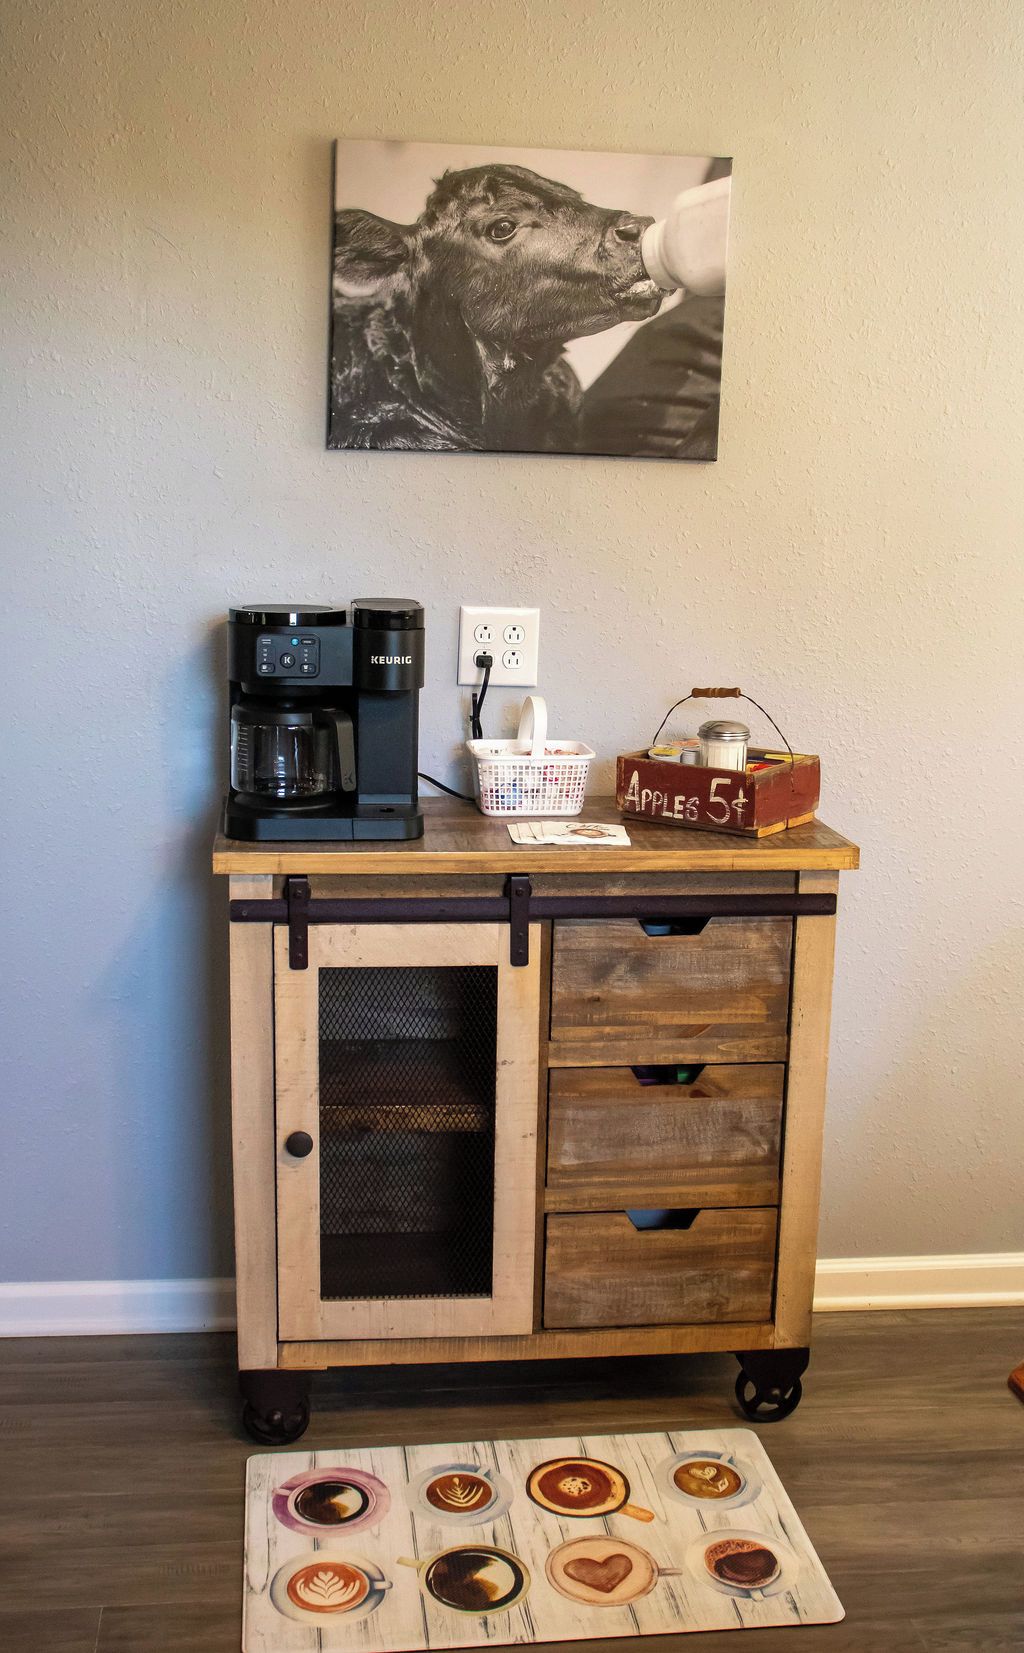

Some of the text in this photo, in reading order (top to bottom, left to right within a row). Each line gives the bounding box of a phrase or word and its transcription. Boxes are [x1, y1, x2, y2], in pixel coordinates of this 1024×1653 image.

[284, 656, 291, 664] K
[371, 655, 412, 665] KEURIG
[624, 769, 699, 822] APPLES
